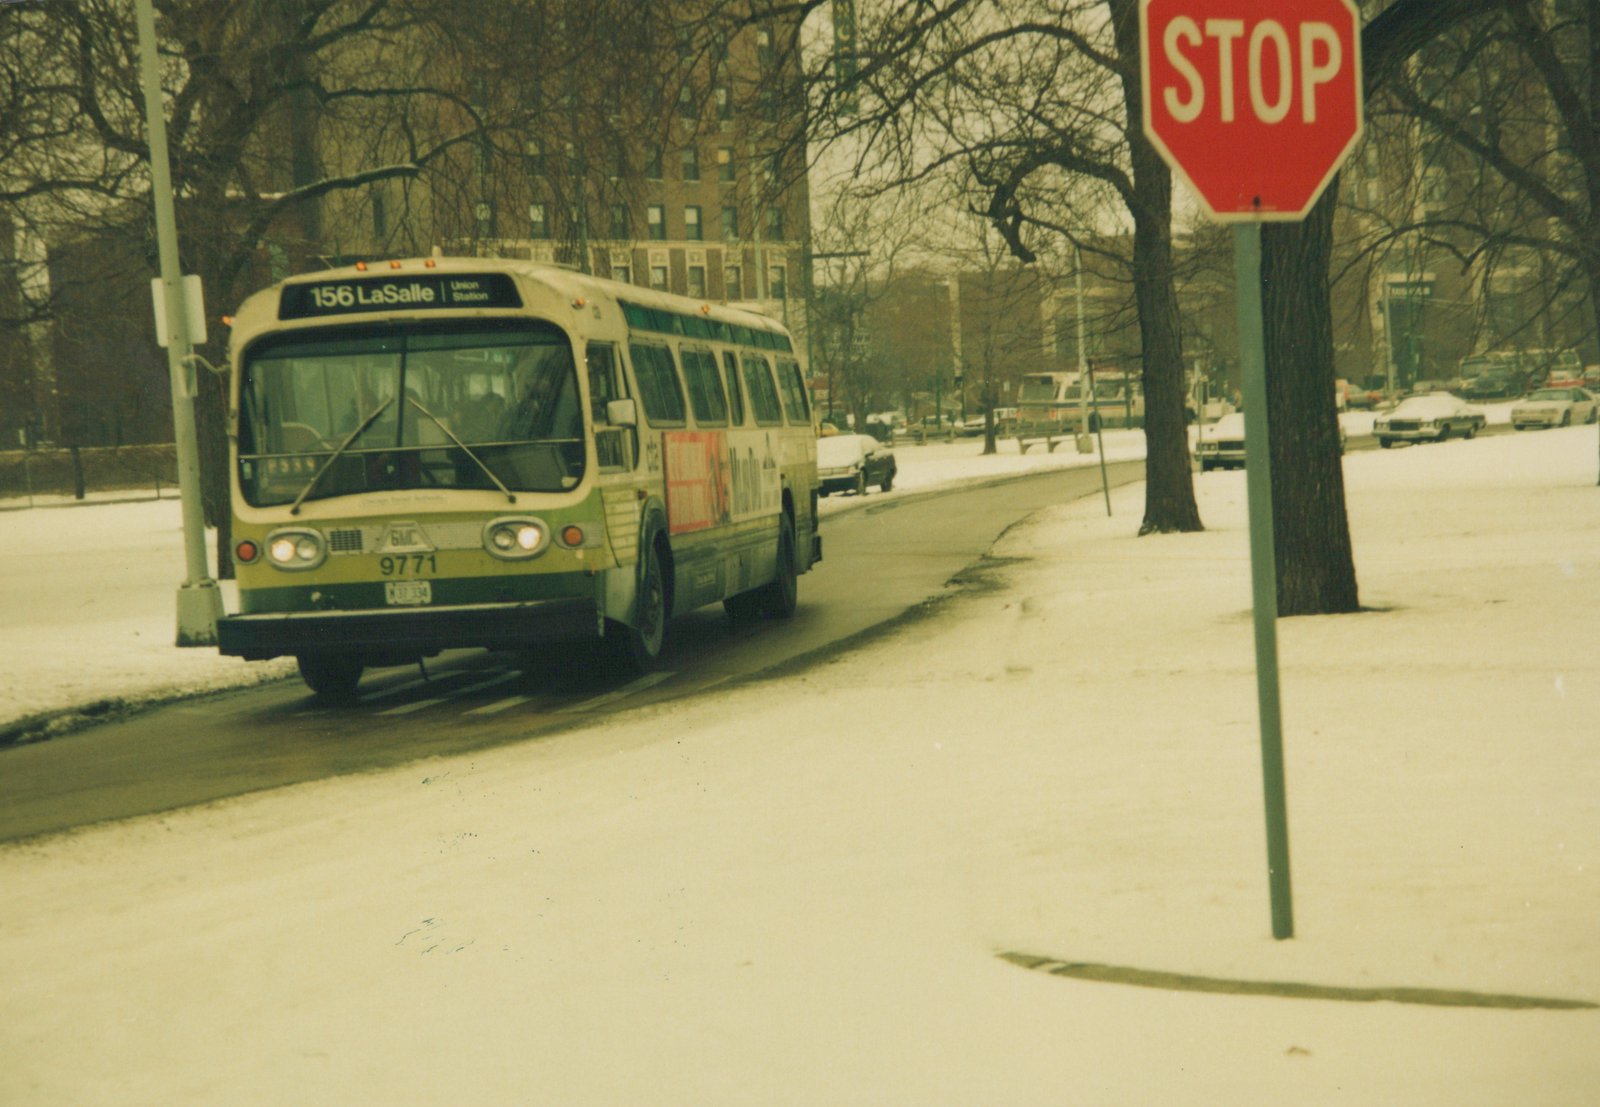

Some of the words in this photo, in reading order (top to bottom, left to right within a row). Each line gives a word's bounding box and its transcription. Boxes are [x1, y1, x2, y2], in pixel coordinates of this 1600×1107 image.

[1163, 15, 1342, 124] STOP
[451, 280, 479, 290] Union
[312, 285, 355, 307] 156
[357, 283, 434, 304] LaSalle
[452, 290, 489, 301] Station
[391, 528, 418, 546] GMC
[380, 555, 437, 575] 9771
